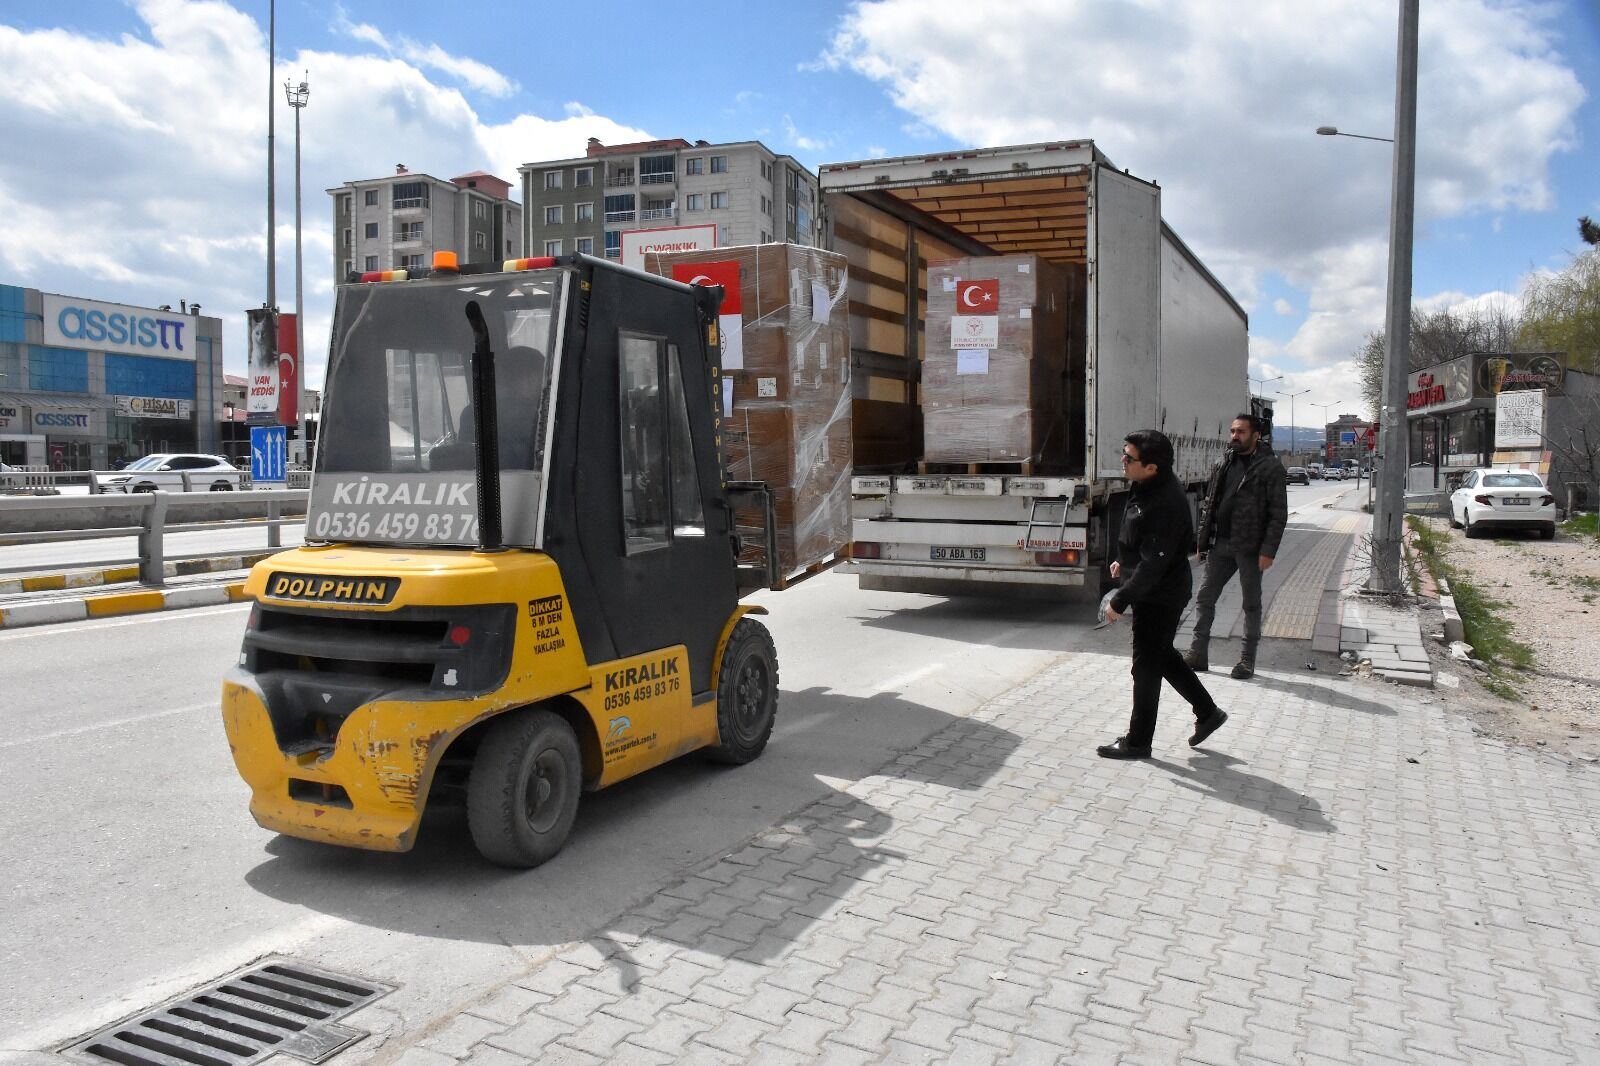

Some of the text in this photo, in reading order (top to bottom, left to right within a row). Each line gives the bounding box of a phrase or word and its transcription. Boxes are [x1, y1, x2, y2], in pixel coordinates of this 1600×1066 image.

[255, 376, 271, 385] VAN
[332, 476, 475, 506] KİRALIK
[315, 511, 371, 538] 0536
[374, 512, 419, 539] 459
[423, 513, 454, 540] 83
[936, 548, 984, 559] 50 ABA 163
[274, 577, 387, 600] DOLPHIN
[529, 598, 562, 616] DİKKAT
[531, 612, 562, 628] 8 M DEN
[536, 626, 560, 641] FAZLA
[533, 638, 566, 655] YAKLAŞMA
[604, 677, 680, 711] 0536 459 83 76
